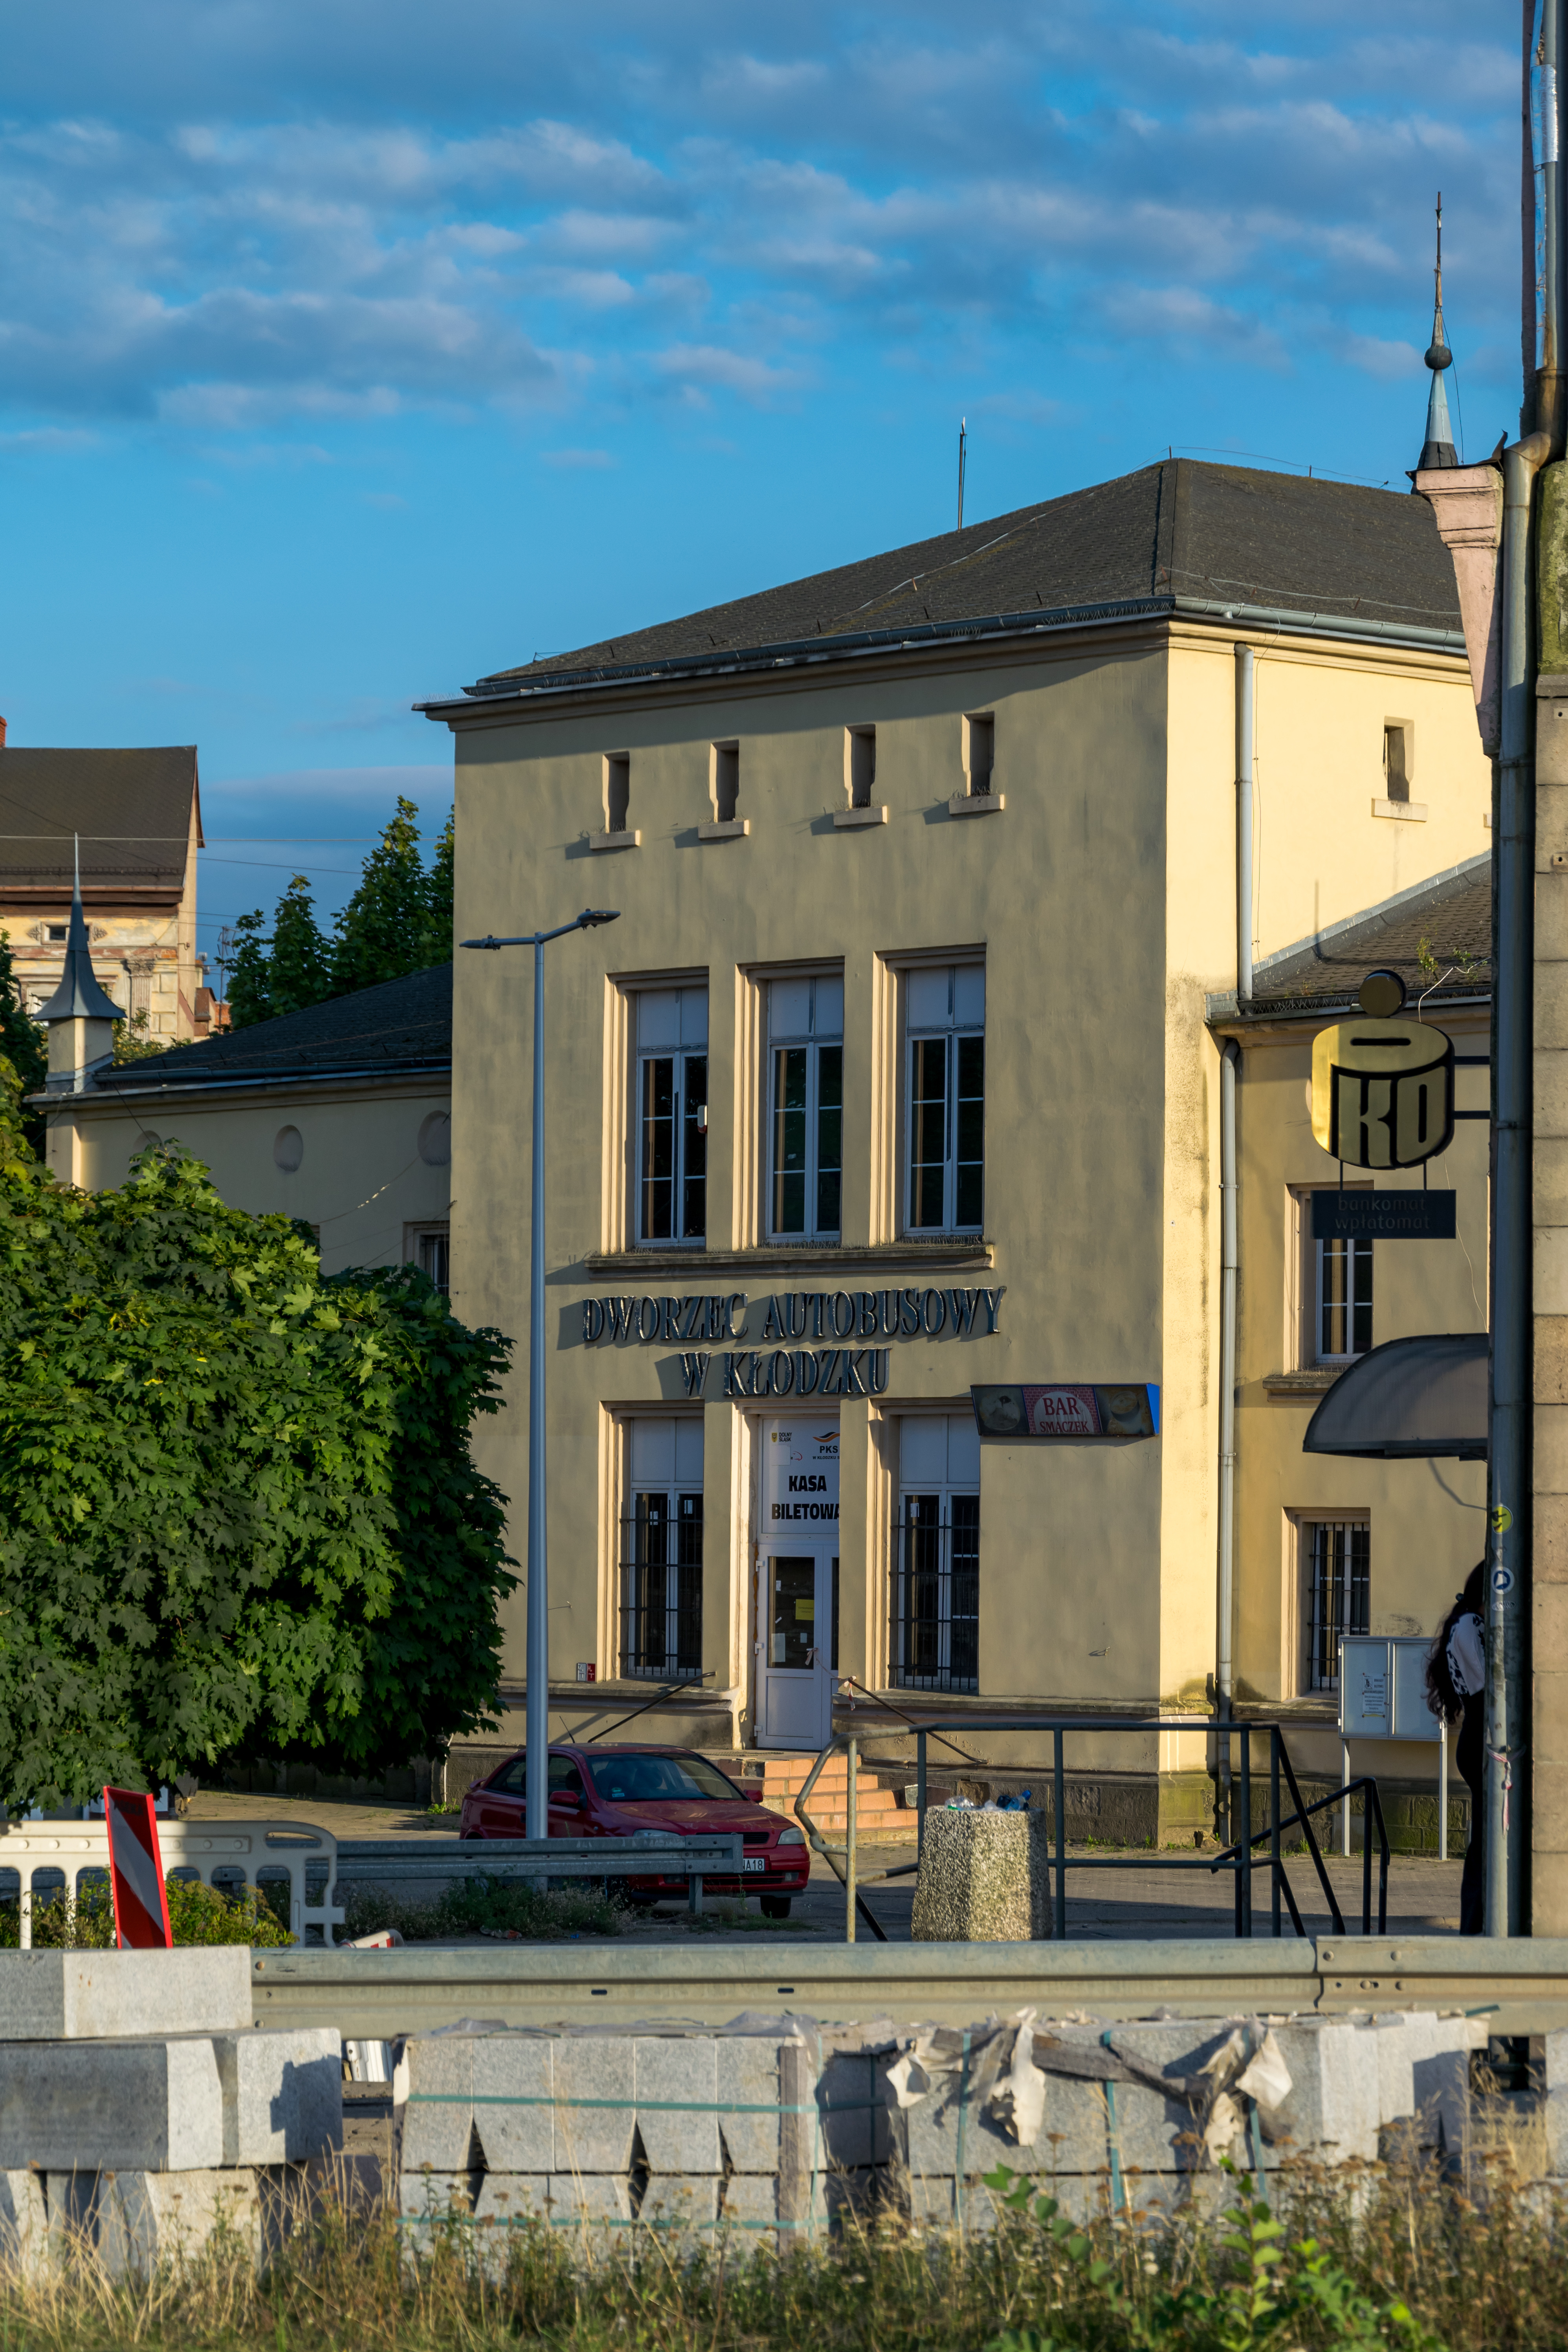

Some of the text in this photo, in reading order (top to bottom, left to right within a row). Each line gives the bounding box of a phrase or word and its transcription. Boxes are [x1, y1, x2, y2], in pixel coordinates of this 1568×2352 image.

[1338, 1195, 1425, 1211] bankomat
[1335, 1214, 1431, 1233] wpłatomat
[582, 1286, 1007, 1341] DWORZEC AUTOBUSOWY
[678, 1347, 893, 1396] W KŁODZKU
[1042, 1397, 1081, 1415] BAR
[1040, 1421, 1089, 1433] SMACZEK
[789, 1475, 827, 1492] KASA
